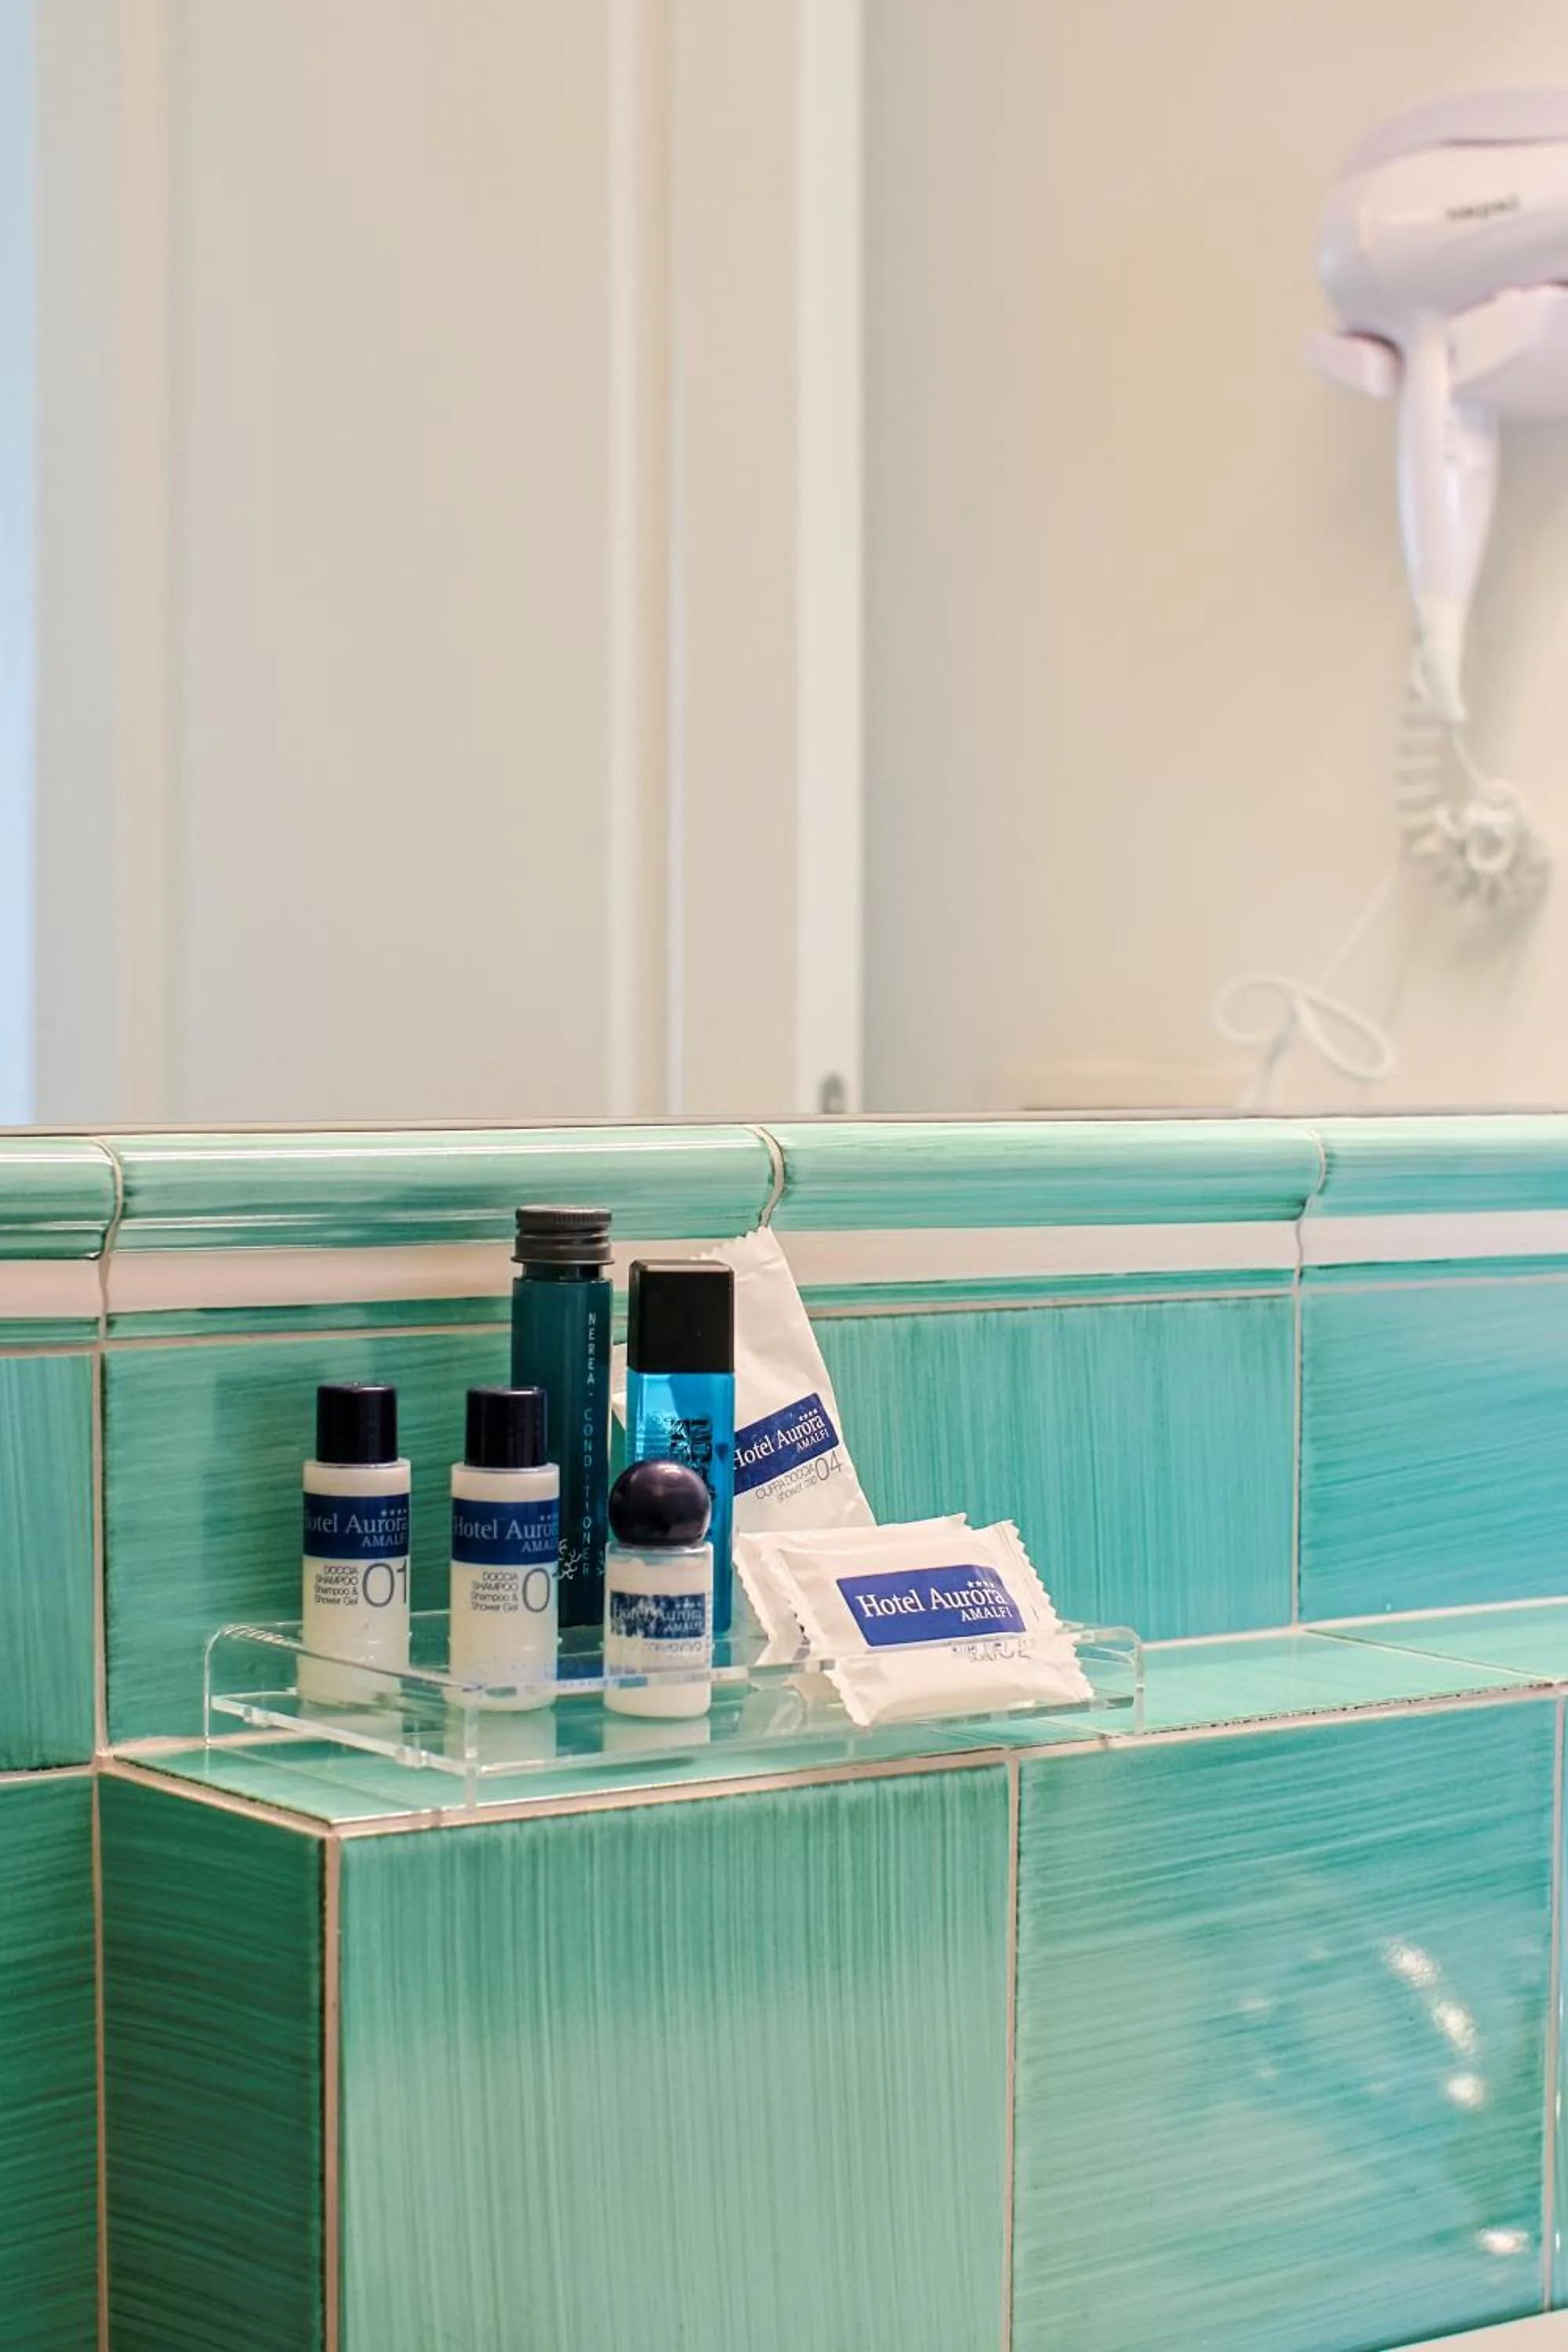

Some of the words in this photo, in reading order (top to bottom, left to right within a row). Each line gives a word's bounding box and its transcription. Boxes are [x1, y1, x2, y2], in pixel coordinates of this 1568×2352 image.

[587, 1312, 597, 1385] NEREA
[776, 1414, 826, 1450] Aurora
[796, 1428, 830, 1451] AMALFI
[815, 1451, 843, 1481] 04
[305, 1512, 339, 1534] otel
[454, 1515, 499, 1540] Hotel
[362, 1558, 407, 1607] 01
[856, 1589, 925, 1617] Hotel
[931, 1586, 1008, 1610] Aurora
[961, 1606, 1013, 1622] AMALFI
